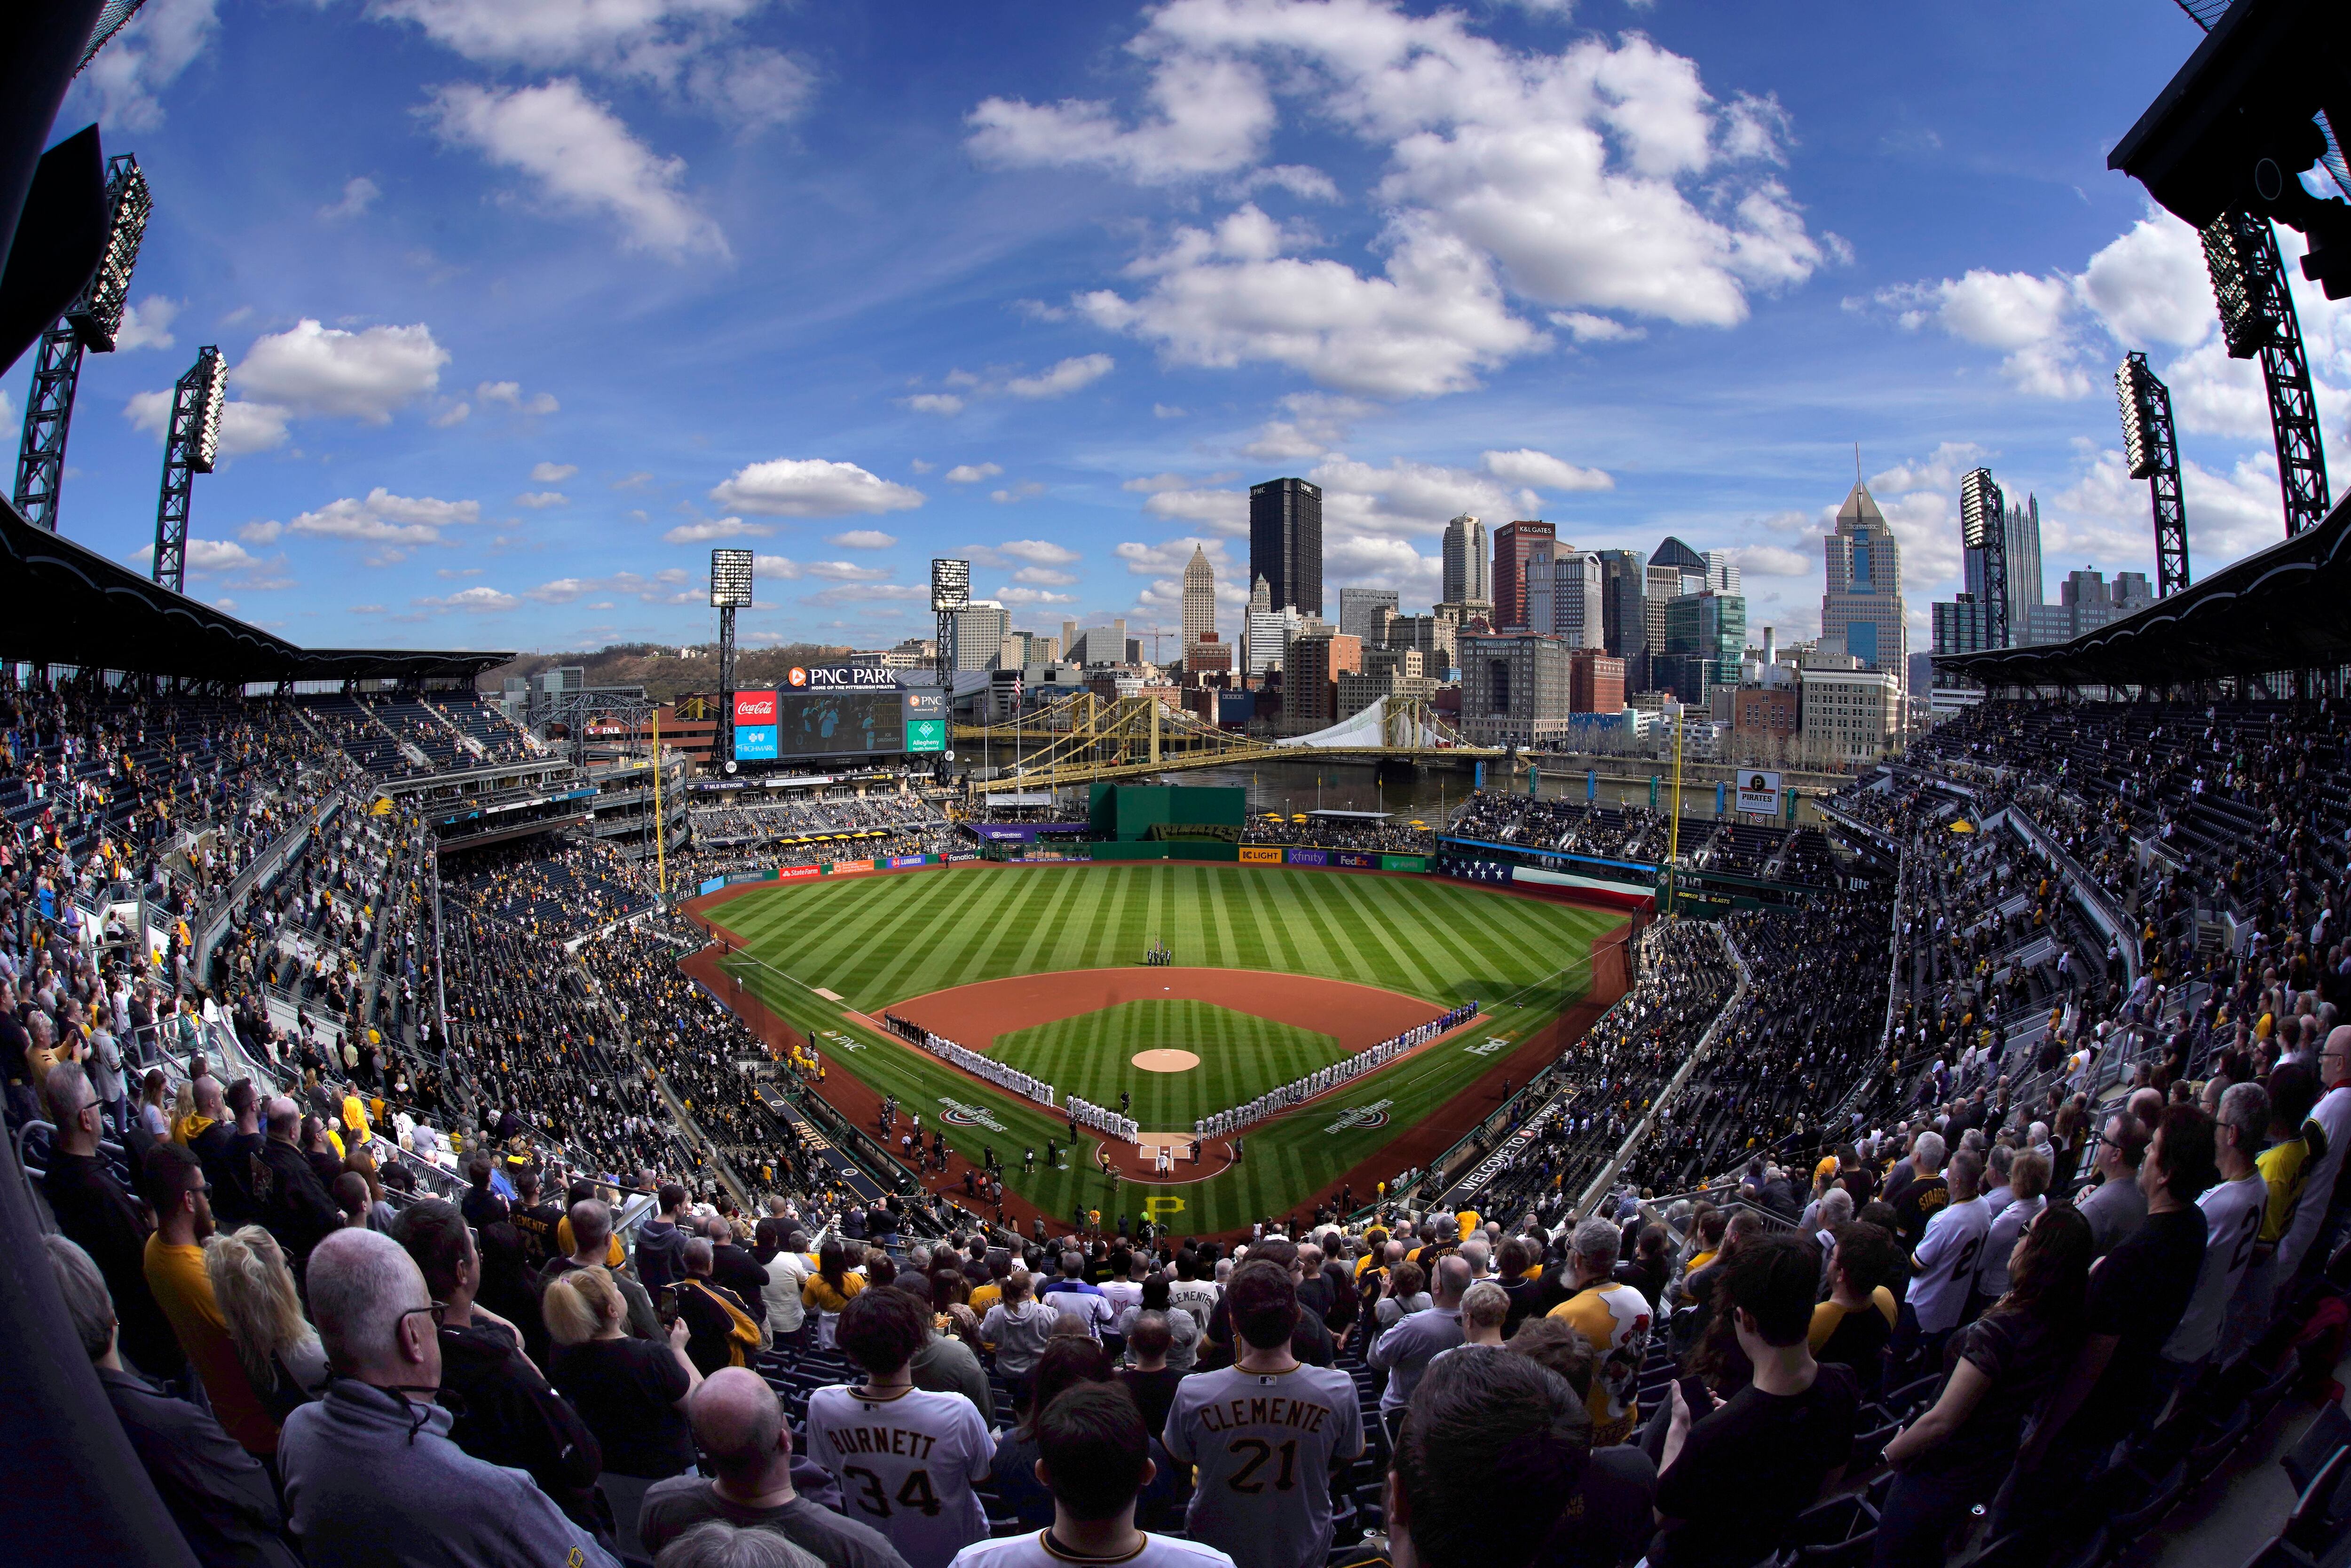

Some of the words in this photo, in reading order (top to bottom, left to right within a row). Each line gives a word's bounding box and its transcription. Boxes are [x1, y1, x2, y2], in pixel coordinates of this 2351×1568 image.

[1251, 487, 1266, 496] UPMC
[1301, 483, 1313, 494] UPMC
[809, 669, 848, 684] PNC
[852, 669, 896, 684] PARK
[738, 701, 773, 715] Coca-Cola
[921, 696, 942, 705] PNC
[1742, 794, 1772, 802] PIRATES
[1292, 852, 1324, 864] xfinity
[1341, 856, 1367, 866] FedEx
[1849, 877, 1870, 892] Lite
[675, 887, 696, 902] AERAS
[832, 1035, 867, 1052] PNC
[938, 1097, 978, 1116] OPENING
[971, 1115, 1008, 1132] SERIES
[1324, 1113, 1366, 1134] OPENING
[1360, 1099, 1394, 1115] SERIES
[791, 1121, 830, 1150] PIRATES
[1458, 1148, 1513, 1190] WELCOME
[1506, 1137, 1526, 1148] TO
[1525, 1116, 1545, 1131] PNC
[1543, 1103, 1561, 1118] PARK
[1144, 1196, 1185, 1224] P
[1199, 1397, 1331, 1433] CLEMENTE
[827, 1426, 936, 1460] BURNETT
[1226, 1439, 1297, 1494] 21
[843, 1465, 942, 1519] 34
